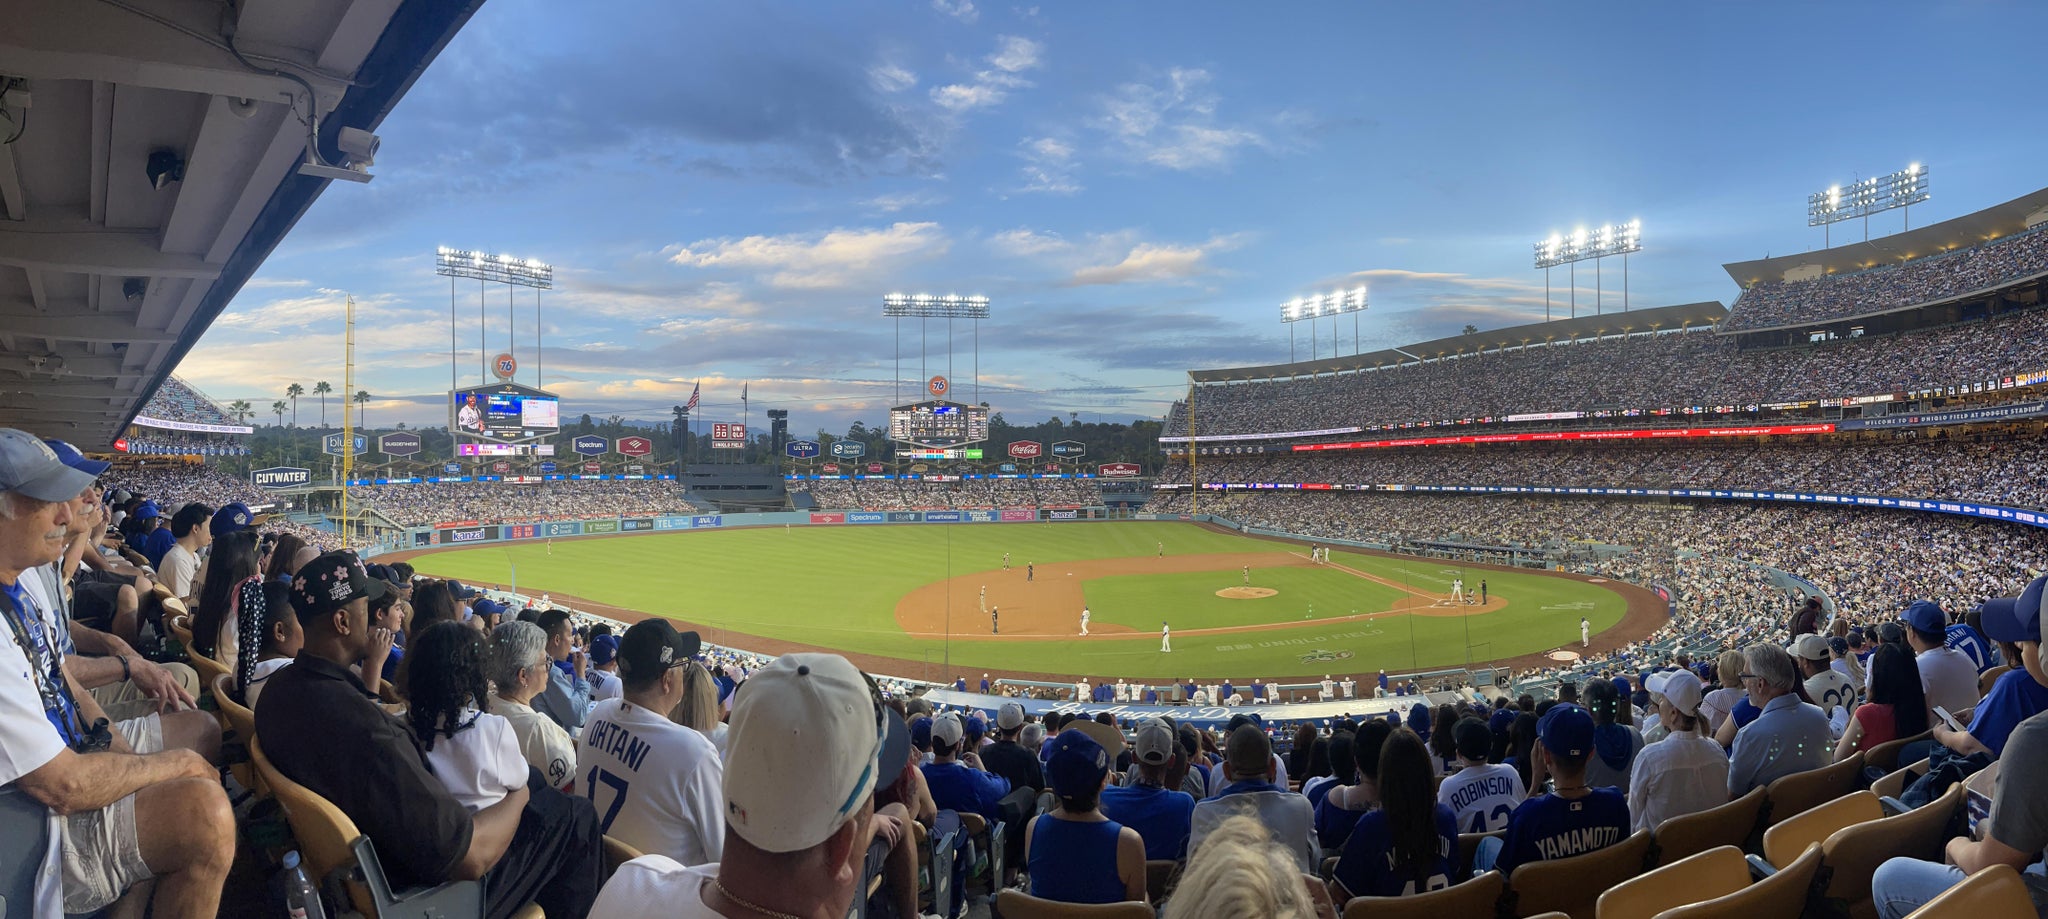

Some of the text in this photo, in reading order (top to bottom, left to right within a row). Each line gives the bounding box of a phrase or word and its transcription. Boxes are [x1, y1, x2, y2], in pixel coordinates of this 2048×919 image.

[500, 360, 512, 371] 76
[933, 382, 945, 390] 76
[1981, 409, 2008, 417] DODGER
[330, 437, 352, 447] blue
[256, 471, 307, 484] CUTWATER
[657, 519, 672, 528] TEL
[330, 585, 350, 596] TOKYO
[331, 589, 353, 600] SERIES
[1259, 628, 1384, 648] UNIQLO FIELD
[1954, 636, 1985, 669] 17
[1037, 702, 1086, 716] Los
[1087, 705, 1191, 720] Angeles
[588, 719, 651, 773] OHTANI
[587, 765, 629, 834] 17
[1451, 777, 1513, 813] ROBINSON
[1470, 803, 1511, 834] 42
[1534, 826, 1619, 861] YAMAMOTO
